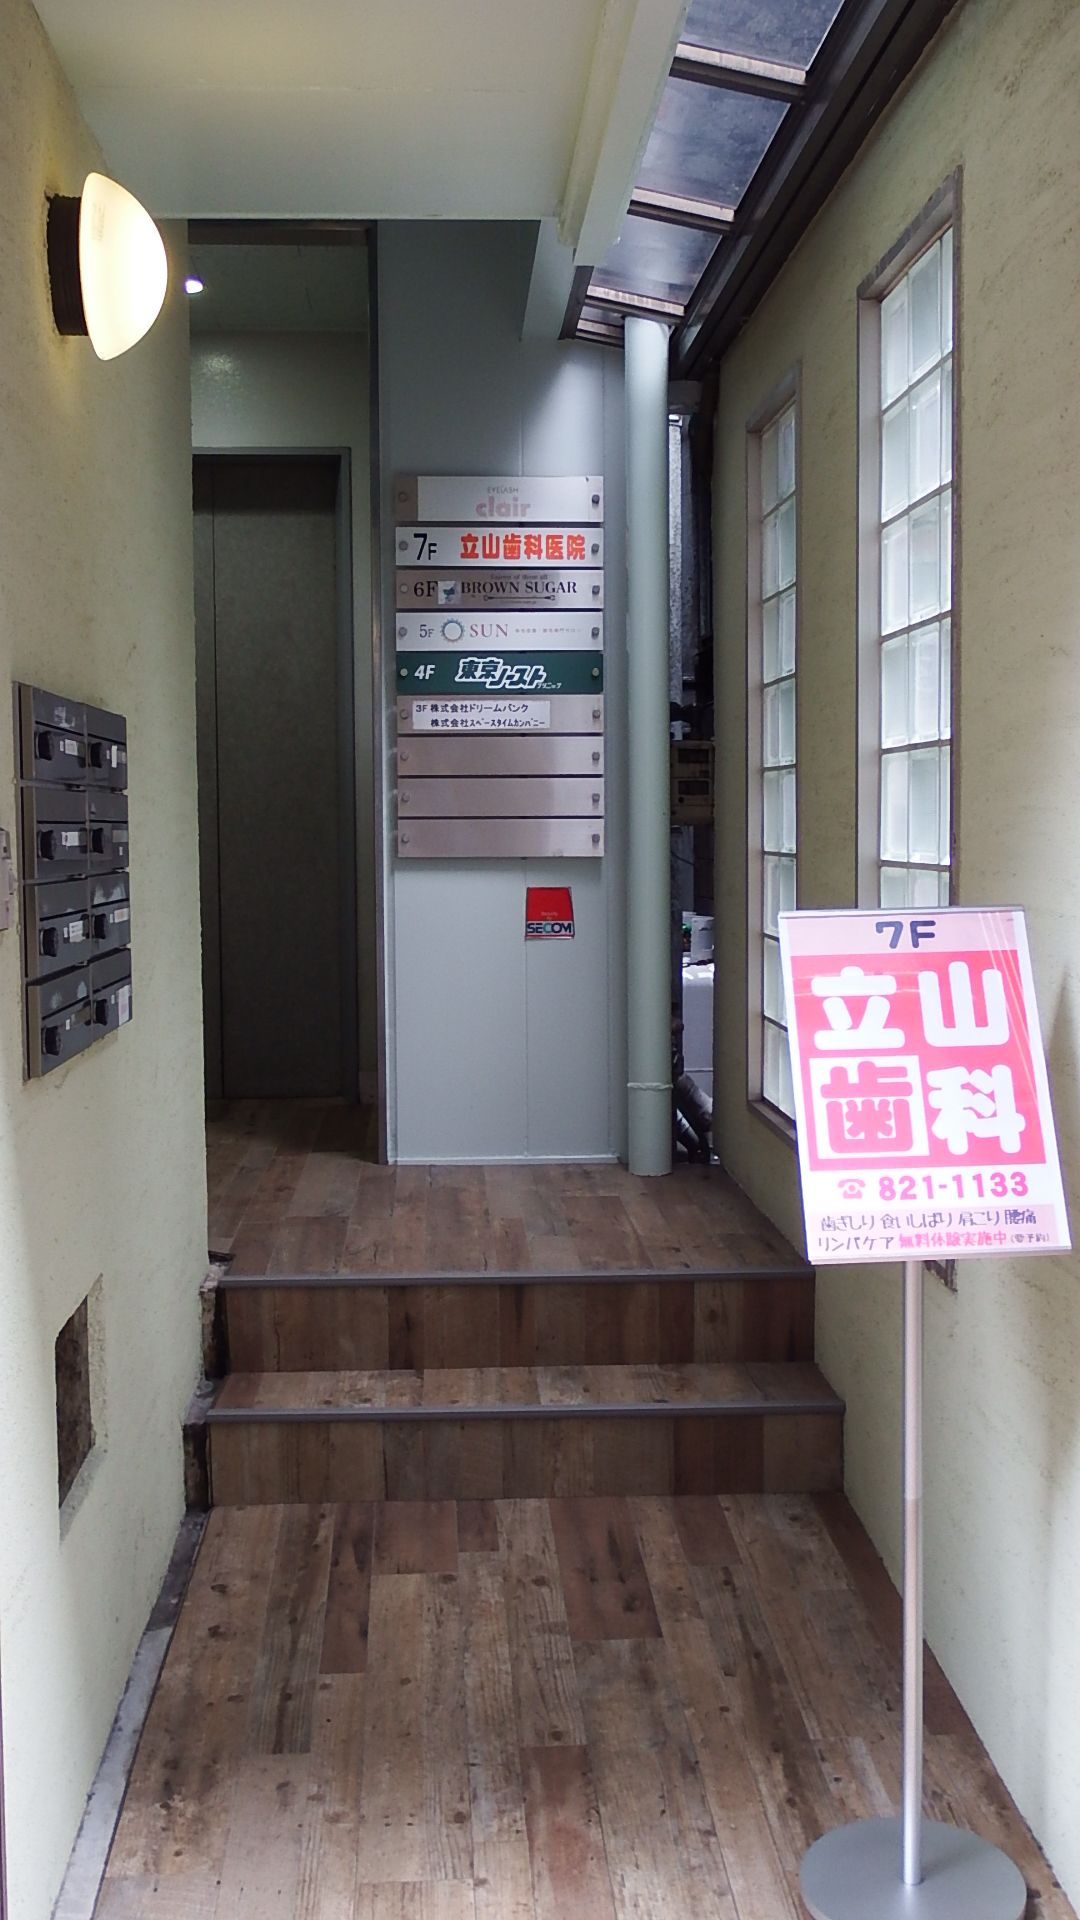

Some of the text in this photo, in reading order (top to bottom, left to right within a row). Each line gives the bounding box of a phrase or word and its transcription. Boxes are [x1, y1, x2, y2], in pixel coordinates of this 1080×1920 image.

[487, 486, 519, 494] EYELASH
[476, 495, 531, 517] clair
[413, 532, 438, 561] 7F
[460, 532, 586, 561] 立山歯科医院
[413, 580, 438, 598] 6F
[461, 581, 577, 594] BROWN SUGAR
[419, 625, 434, 638] 5F
[469, 623, 509, 638] SUN
[414, 664, 436, 680] 4F
[415, 703, 529, 714] 3F 株式会社ドリームバンク
[527, 922, 572, 934] SECOM
[875, 919, 936, 949] 7F
[810, 960, 1011, 1051] 立山
[820, 1060, 1027, 1156] 歯科
[878, 1171, 1030, 1202] 821-1133
[820, 1208, 1037, 1232] 歯ぎしり 食いしばり 肩こり 腰痛
[817, 1235, 895, 1252] リンパケア
[899, 1229, 1007, 1249] 無料体験実施中
